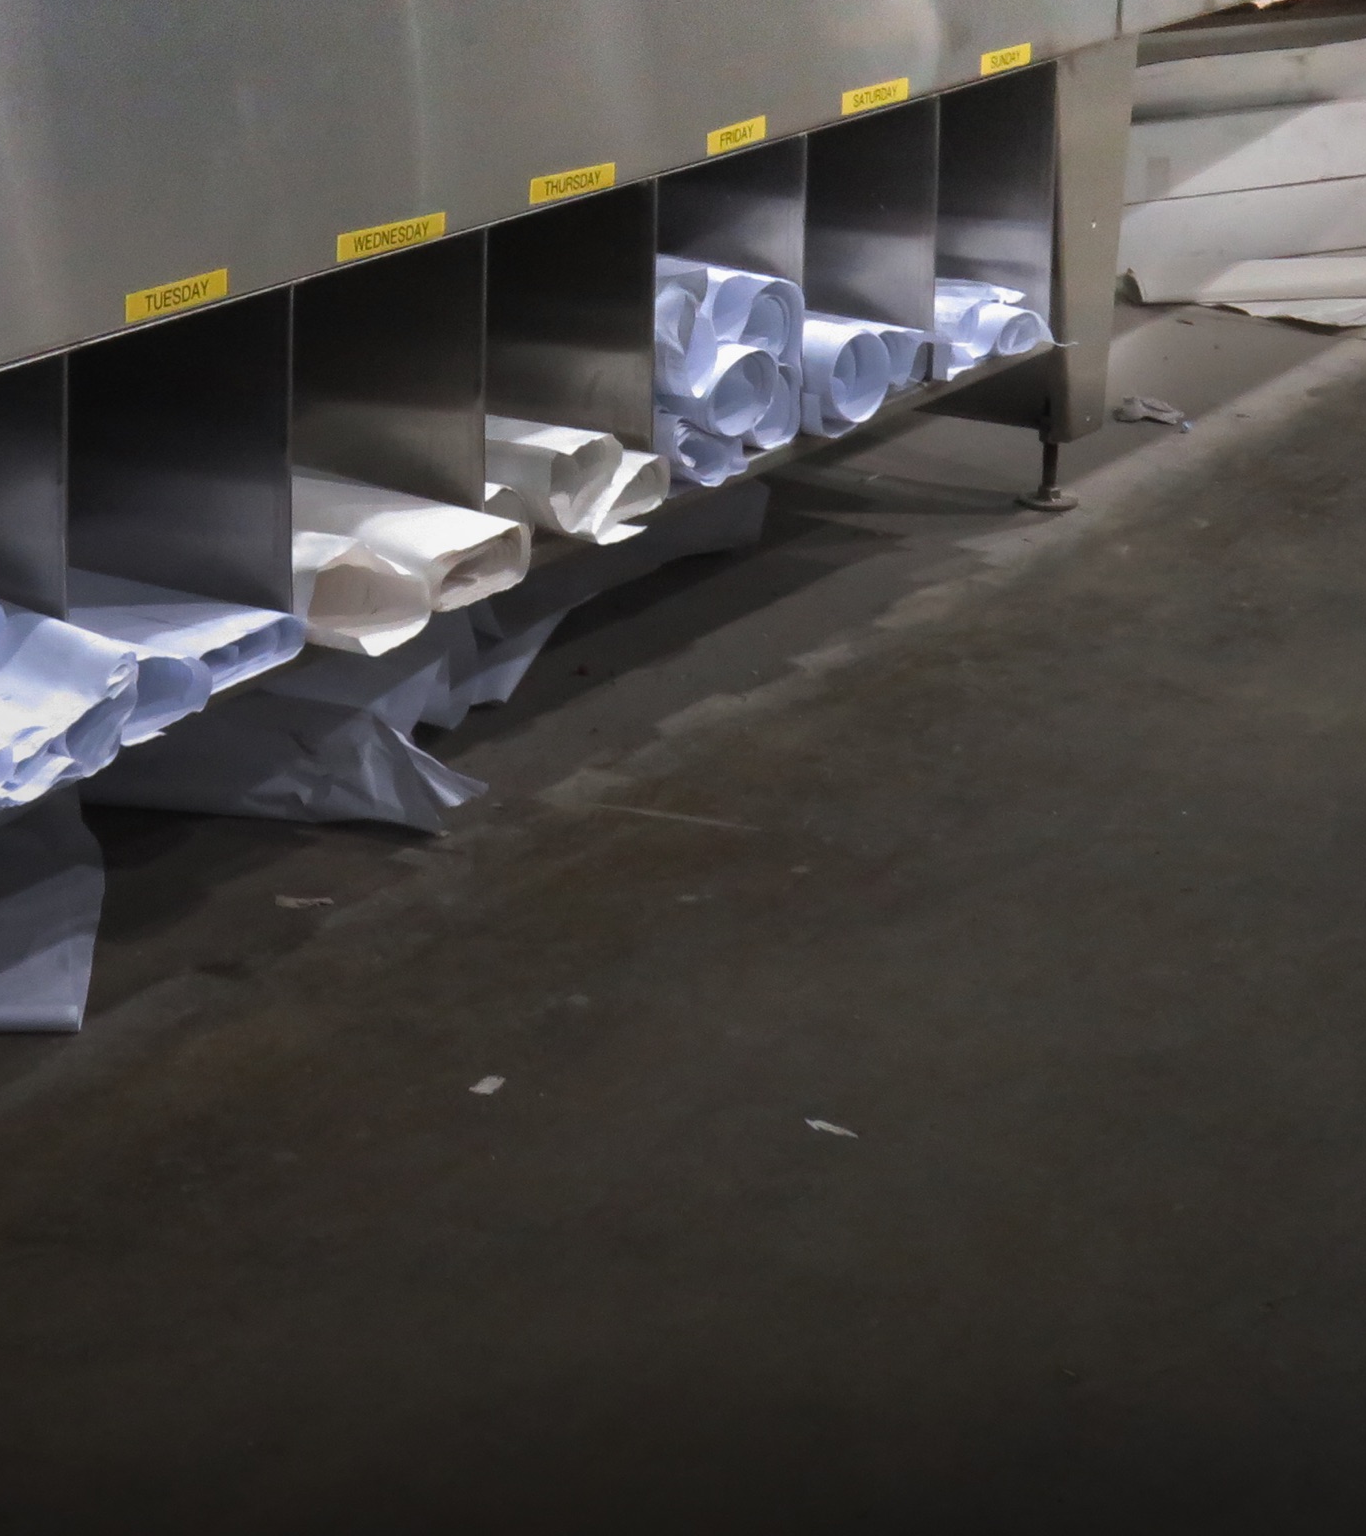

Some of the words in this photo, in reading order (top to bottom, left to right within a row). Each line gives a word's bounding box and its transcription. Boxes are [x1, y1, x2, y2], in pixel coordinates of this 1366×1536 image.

[852, 85, 898, 108] SATURDAY
[719, 124, 755, 149] FRIDAY
[544, 170, 602, 196] THURSDAY
[353, 221, 430, 252] WEDNESDAY
[145, 279, 210, 312] TUESDAY
